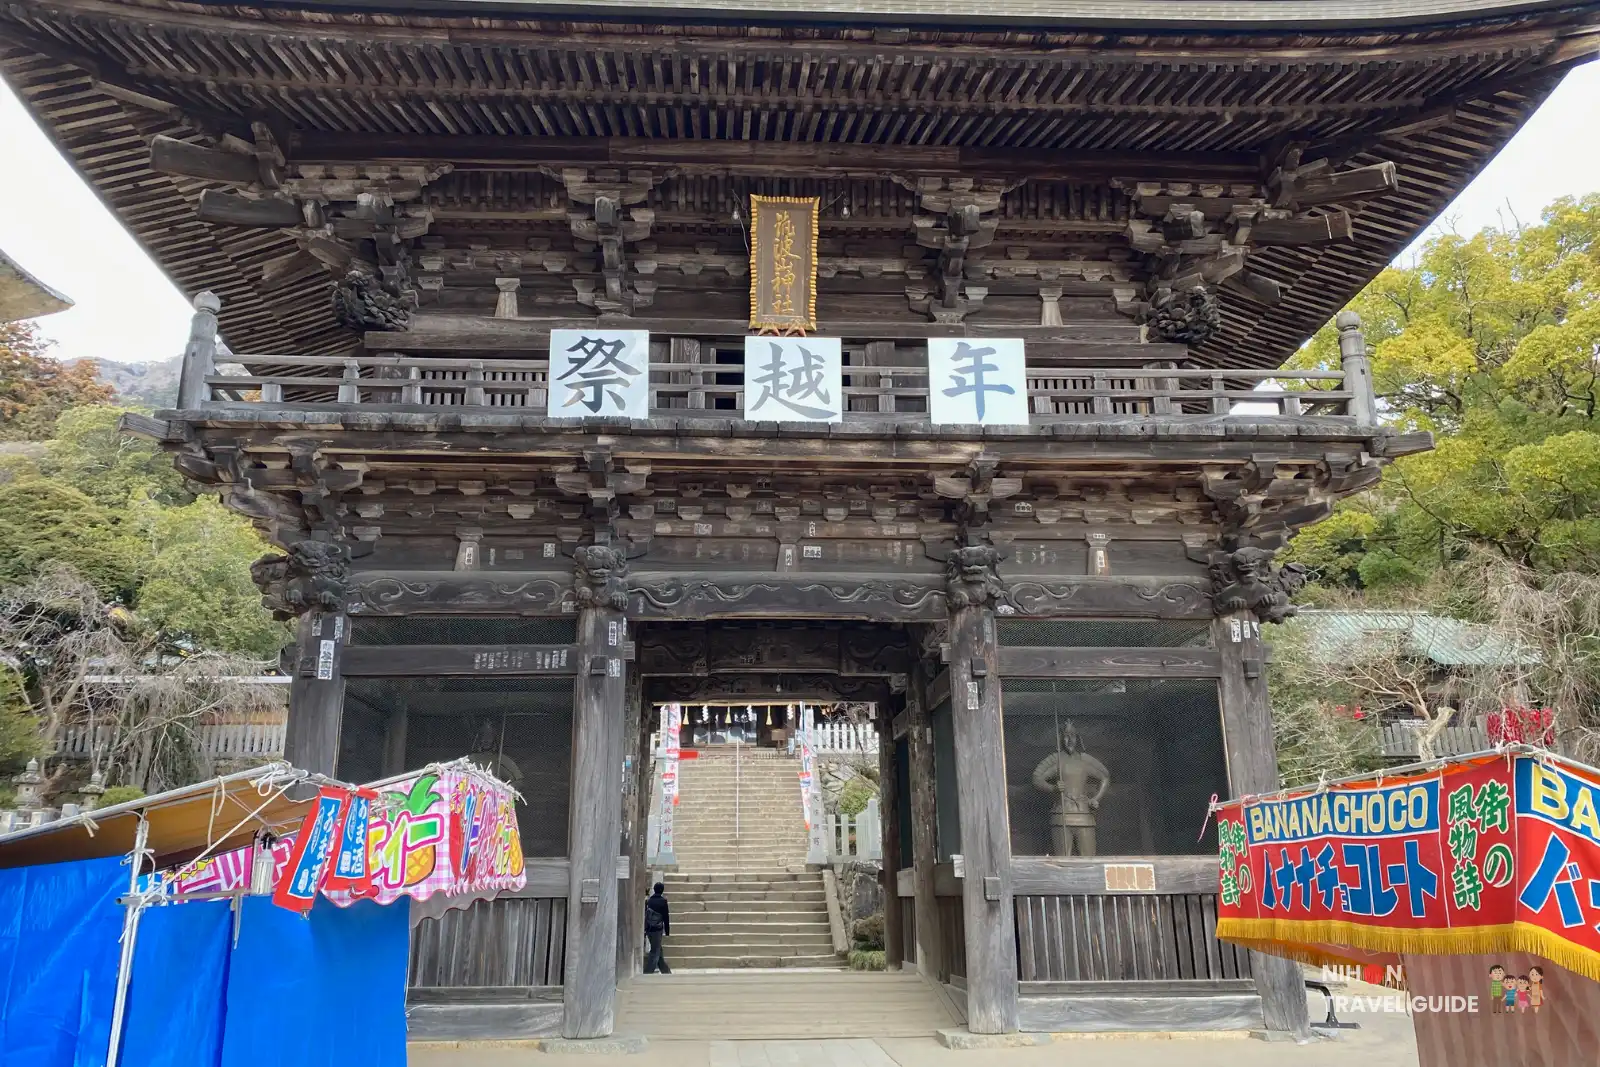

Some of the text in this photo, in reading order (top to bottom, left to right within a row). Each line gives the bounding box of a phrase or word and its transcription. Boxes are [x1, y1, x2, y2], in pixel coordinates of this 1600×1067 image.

[555, 335, 643, 415] 祭
[749, 341, 838, 420] 越
[942, 341, 1016, 423] 年
[1250, 786, 1429, 842] BANANACHOCO
[1446, 783, 1484, 912] 風物詩
[1473, 778, 1515, 889] 街の
[1218, 819, 1241, 908] 風物詩
[1231, 820, 1252, 894] 街の
[1518, 832, 1600, 936] バ
